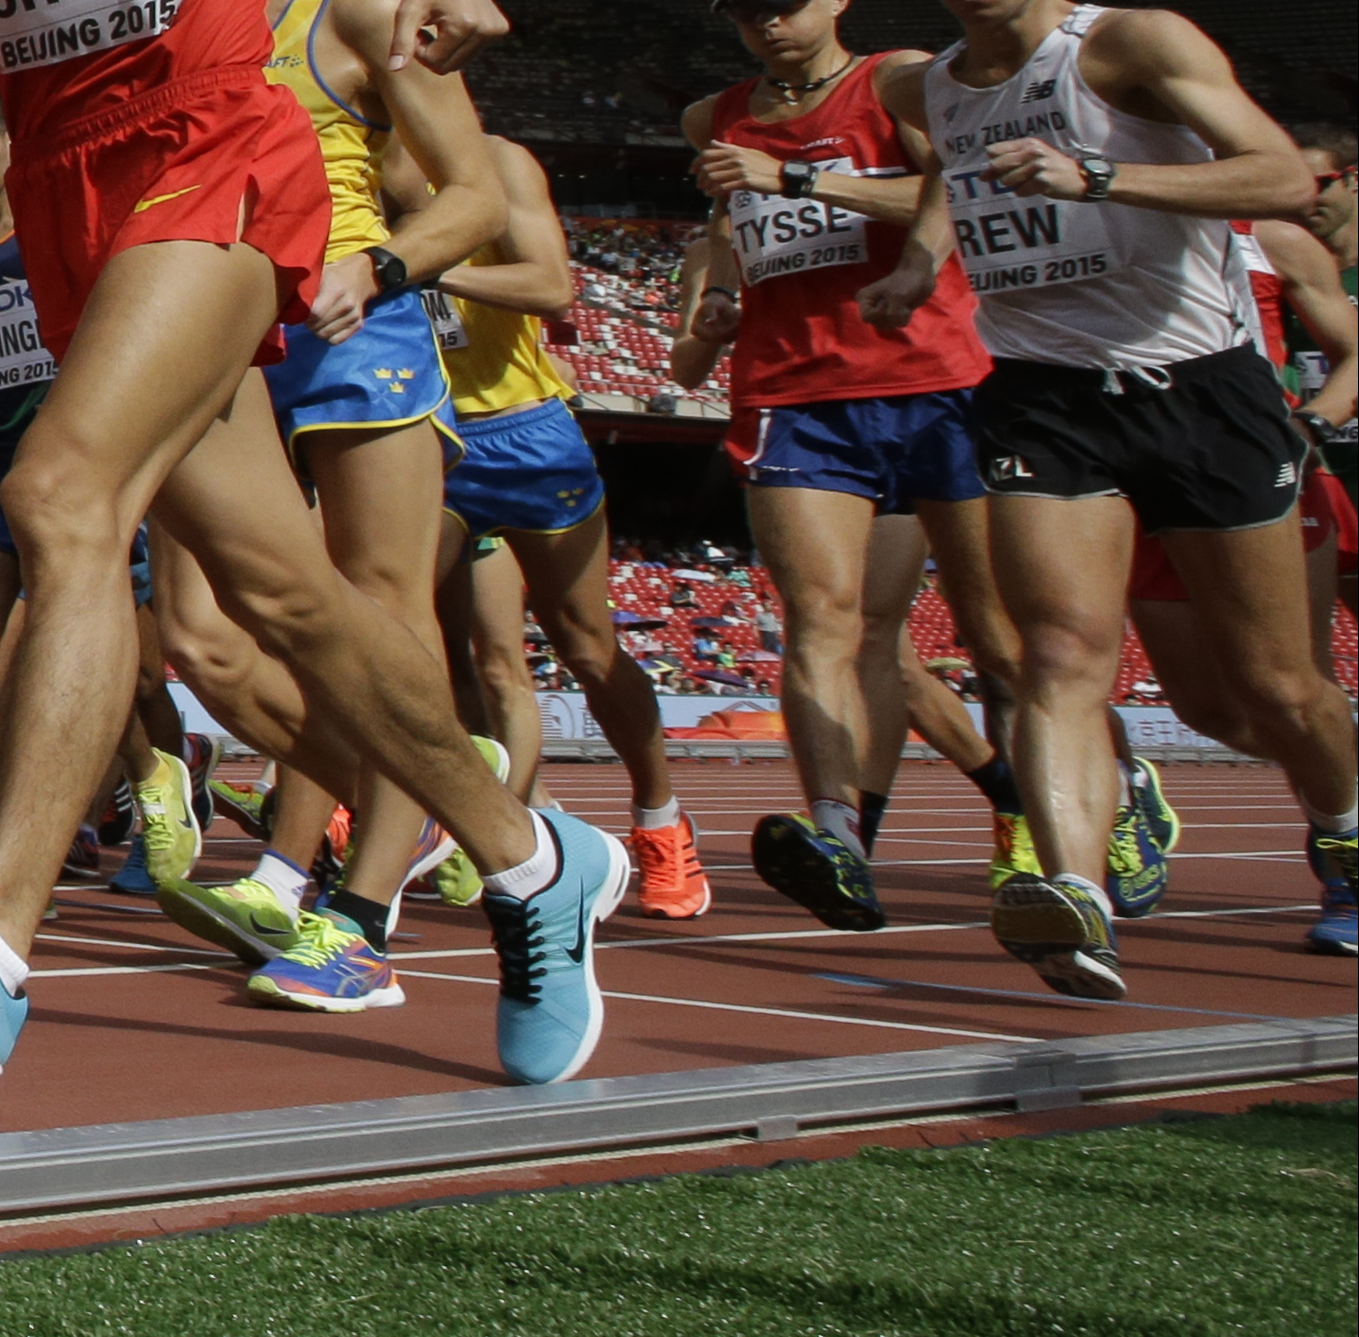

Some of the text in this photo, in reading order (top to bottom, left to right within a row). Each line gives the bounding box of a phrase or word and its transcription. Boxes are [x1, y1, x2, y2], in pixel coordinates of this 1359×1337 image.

[0, 17, 101, 68] BEIJING
[266, 55, 290, 68] AFT
[945, 111, 1066, 157] NEW ZEALAND
[735, 202, 852, 254] TYSSE
[952, 203, 1061, 259] REW
[810, 245, 860, 264] 2015
[969, 253, 1107, 291] EIJING 2015
